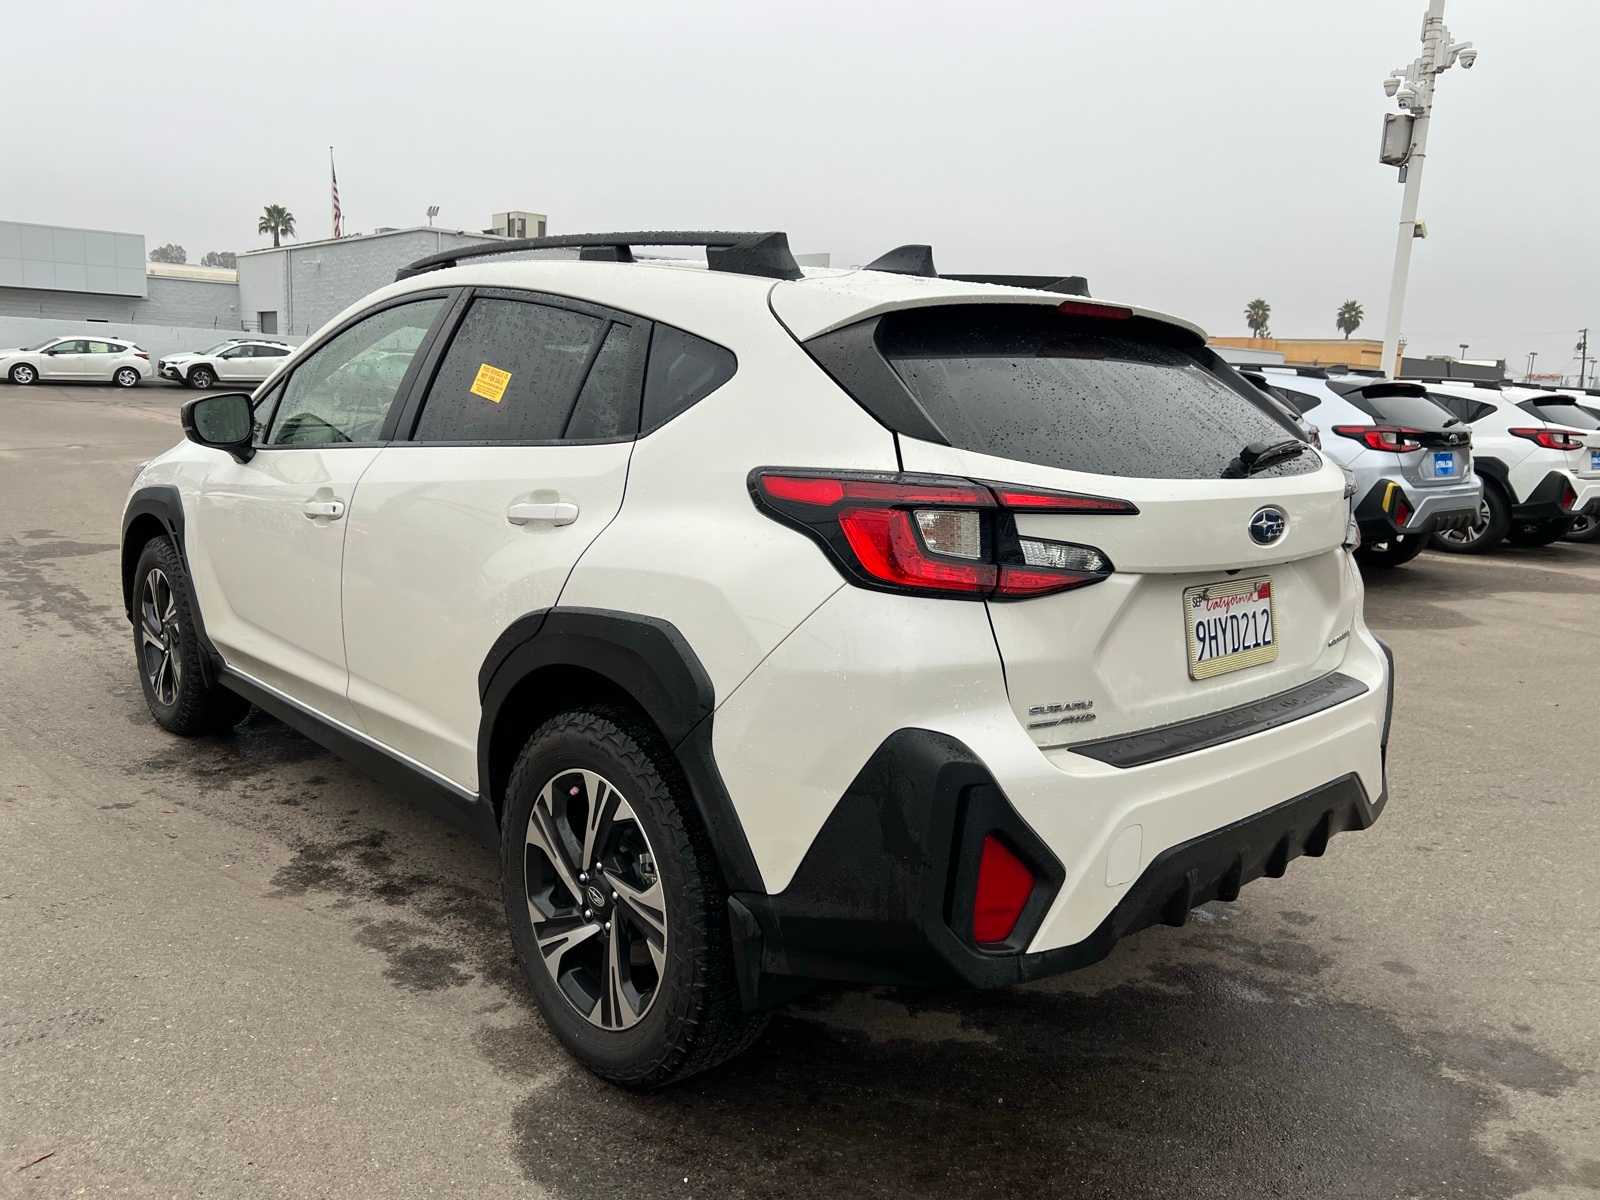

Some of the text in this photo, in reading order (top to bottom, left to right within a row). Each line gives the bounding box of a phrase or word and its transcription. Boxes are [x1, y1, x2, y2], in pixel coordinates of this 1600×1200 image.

[1206, 591, 1253, 614] California
[1195, 608, 1271, 661] 9HYD212
[1029, 700, 1094, 715] SUBARU
